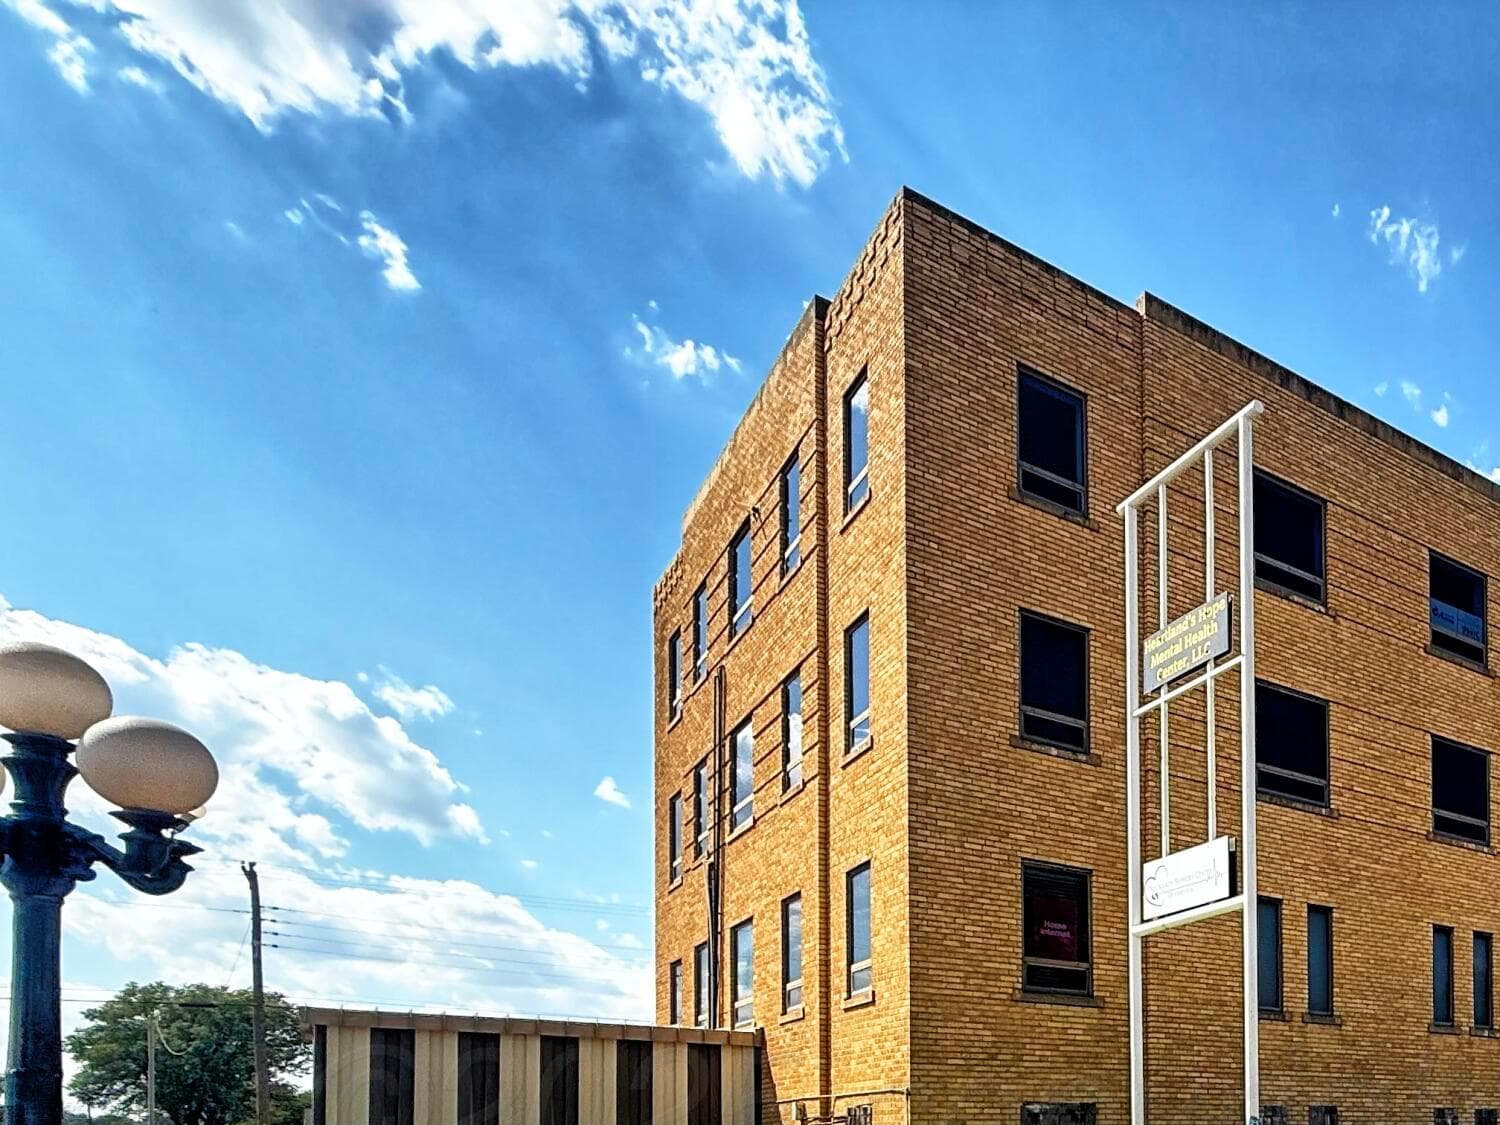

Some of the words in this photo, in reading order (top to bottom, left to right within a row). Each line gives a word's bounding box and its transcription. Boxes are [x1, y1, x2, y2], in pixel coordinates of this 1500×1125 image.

[1144, 613, 1196, 654] Heartland's
[1198, 599, 1226, 623] Hope
[1150, 638, 1183, 669] Mental
[1184, 620, 1218, 649] Health
[1156, 655, 1189, 681] Center,
[1191, 641, 1211, 661] LLC
